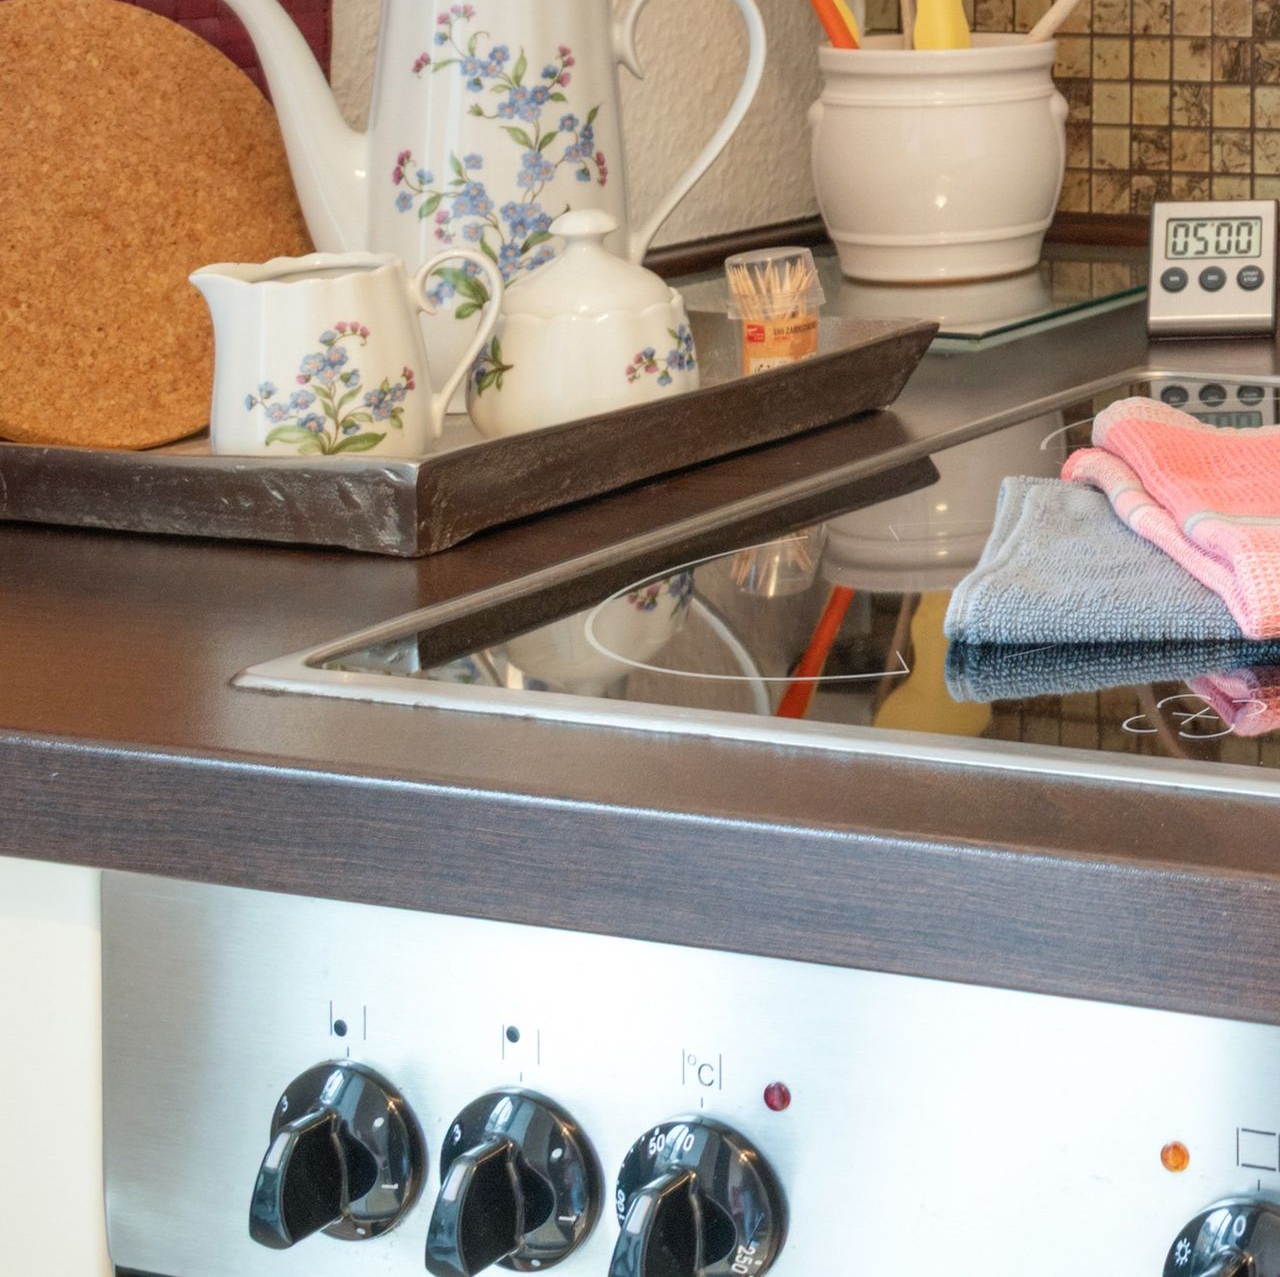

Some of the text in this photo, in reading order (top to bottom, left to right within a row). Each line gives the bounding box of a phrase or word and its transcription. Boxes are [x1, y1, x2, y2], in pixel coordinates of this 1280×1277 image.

[452, 1123, 462, 1144] 3
[683, 1133, 695, 1151] 0
[648, 1134, 667, 1156] 50
[1232, 1214, 1246, 1237] 0
[731, 1244, 756, 1274] 250
